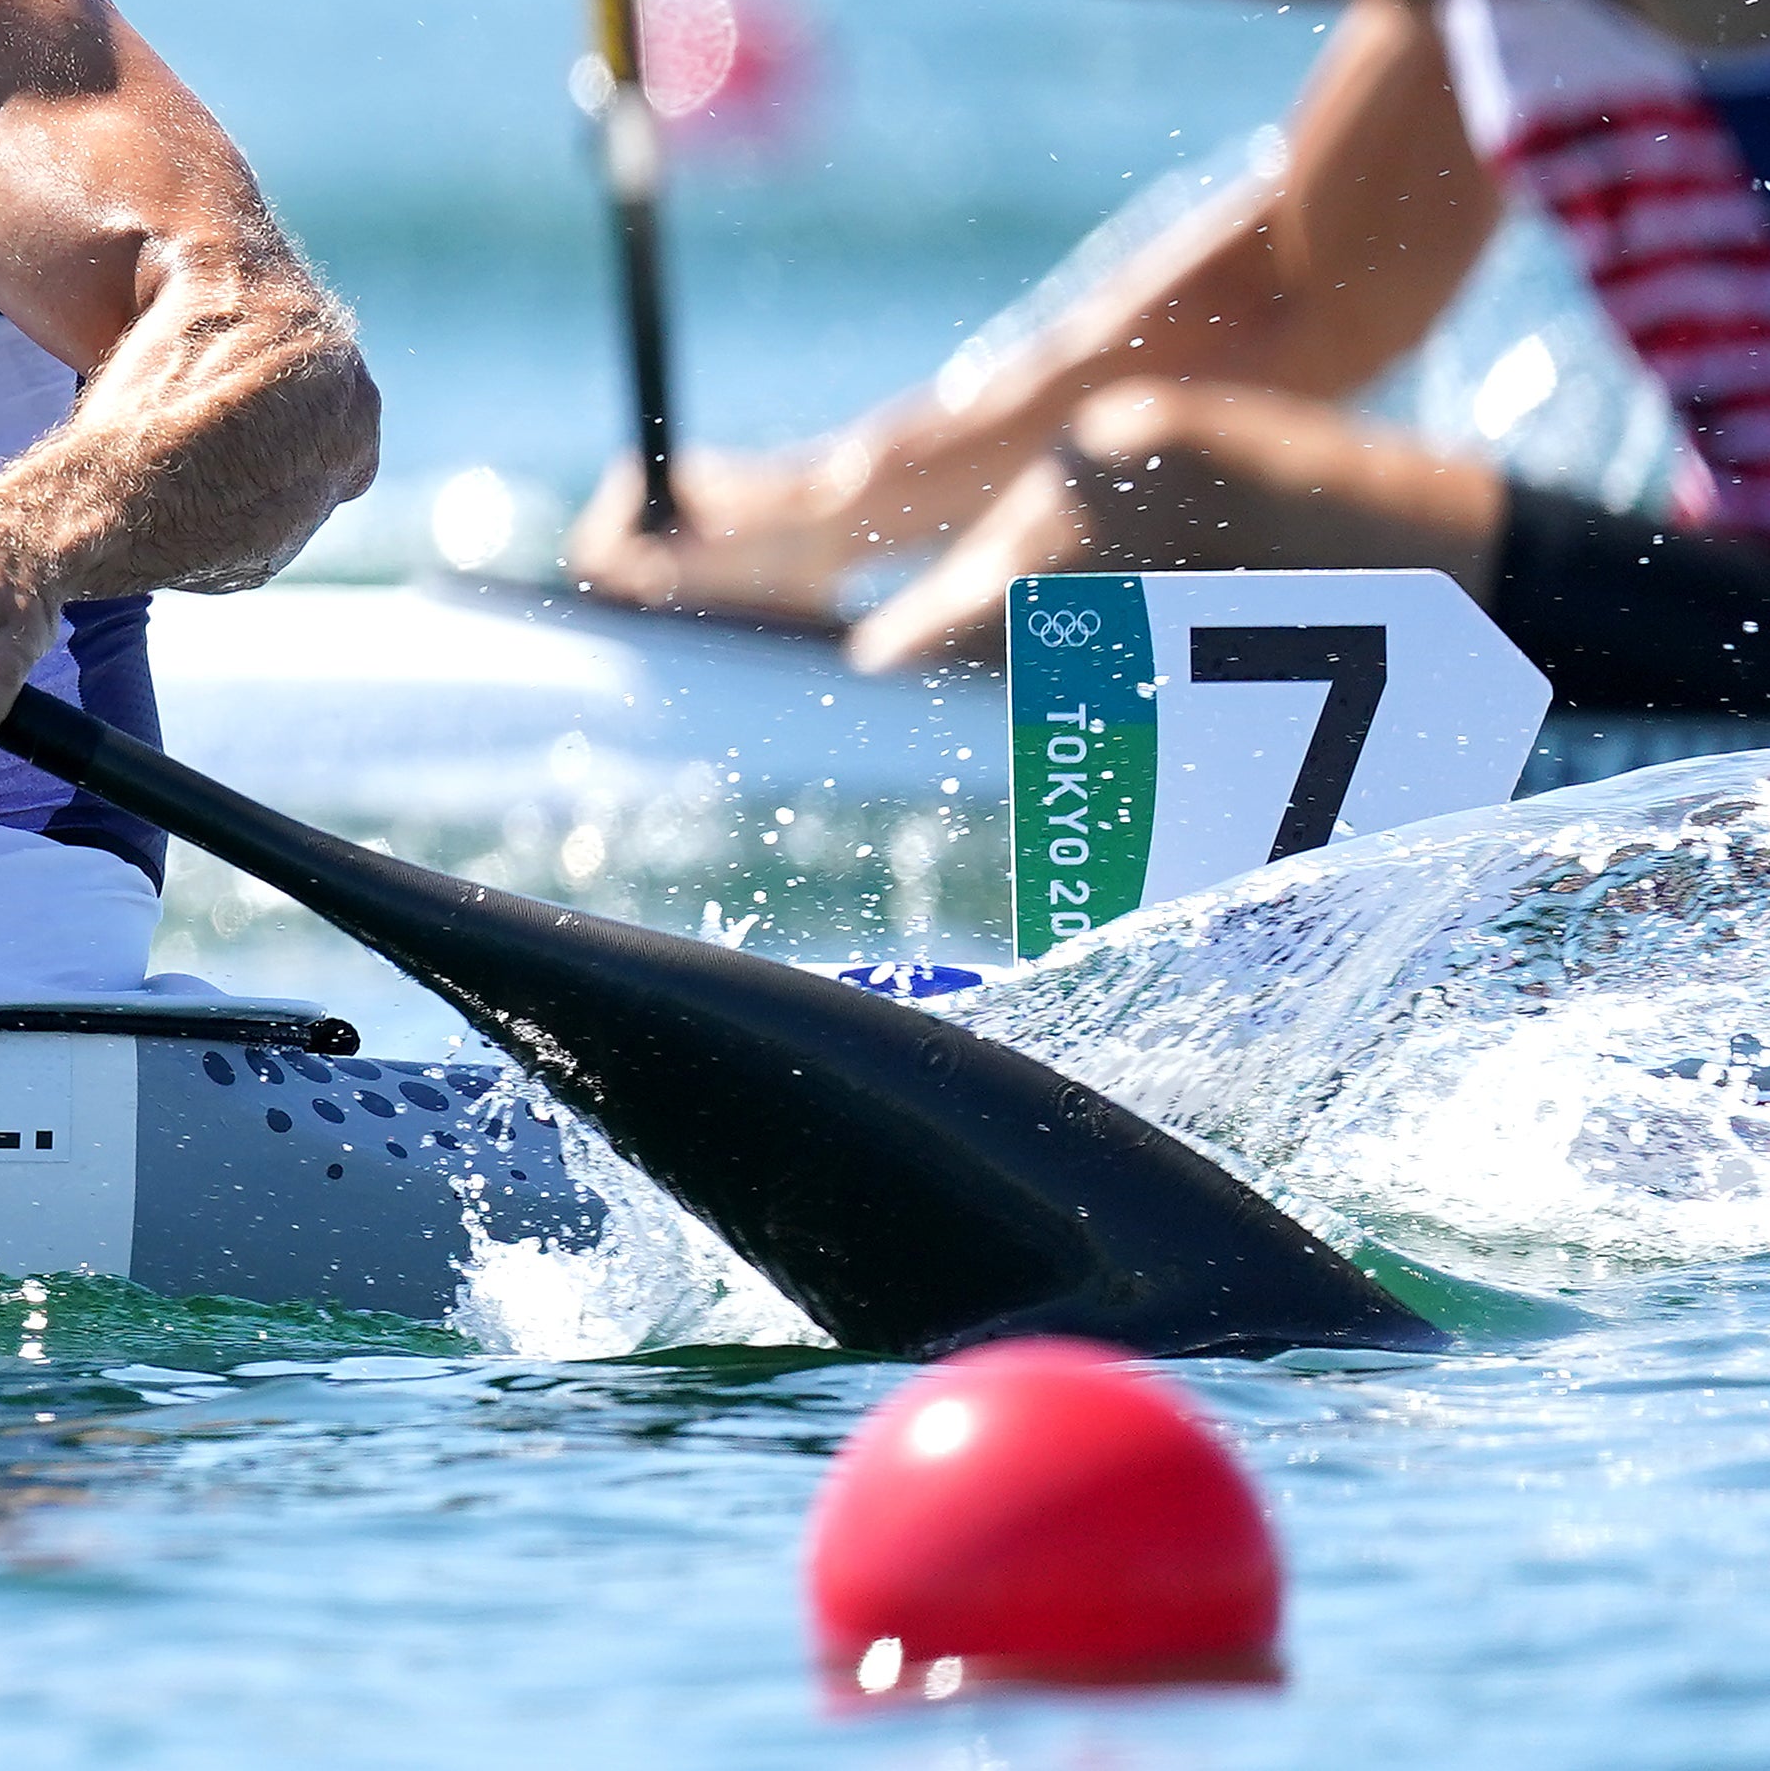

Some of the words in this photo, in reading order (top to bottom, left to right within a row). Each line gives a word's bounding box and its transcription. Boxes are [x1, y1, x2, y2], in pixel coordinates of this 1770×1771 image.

[1046, 702, 1090, 867] TOKYO
[1190, 625, 1387, 864] 7
[1049, 879, 1092, 938] 20
